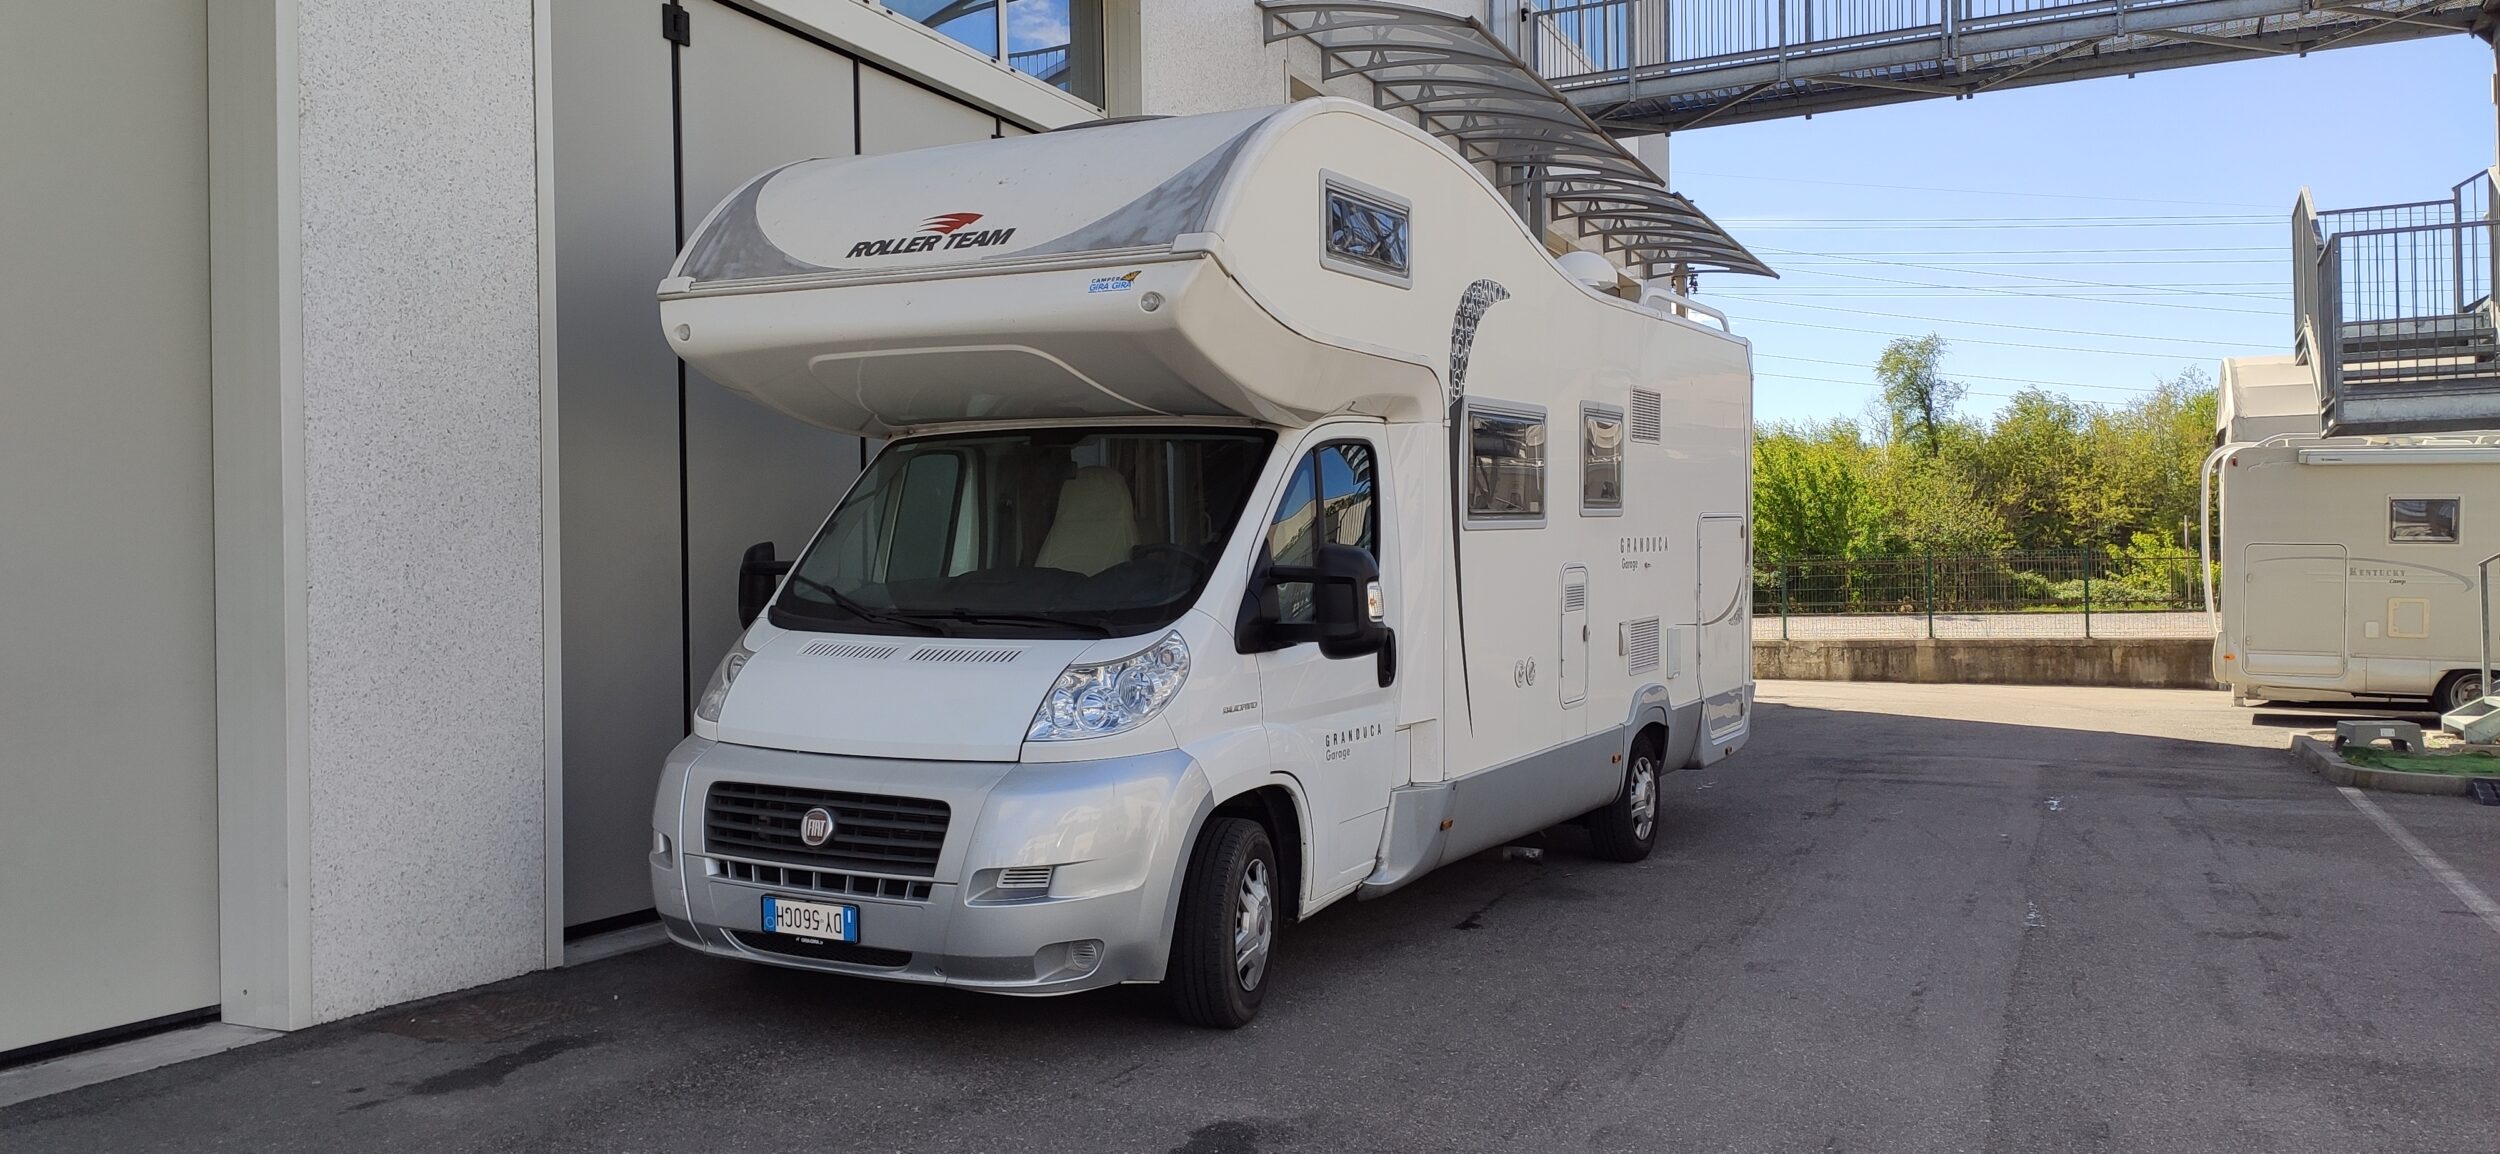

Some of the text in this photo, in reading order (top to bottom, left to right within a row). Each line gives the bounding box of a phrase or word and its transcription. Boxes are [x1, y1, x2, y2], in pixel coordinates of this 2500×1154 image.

[845, 227, 1017, 258] ROLLER TEAM
[1089, 280, 1131, 291] GIRA GIRA
[1620, 536, 1668, 553] GRANDUCA
[1622, 557, 1638, 571] Garage
[1325, 723, 1382, 747] GRANDUCA
[1325, 748, 1351, 761] Garage
[807, 819, 826, 837] FIAT
